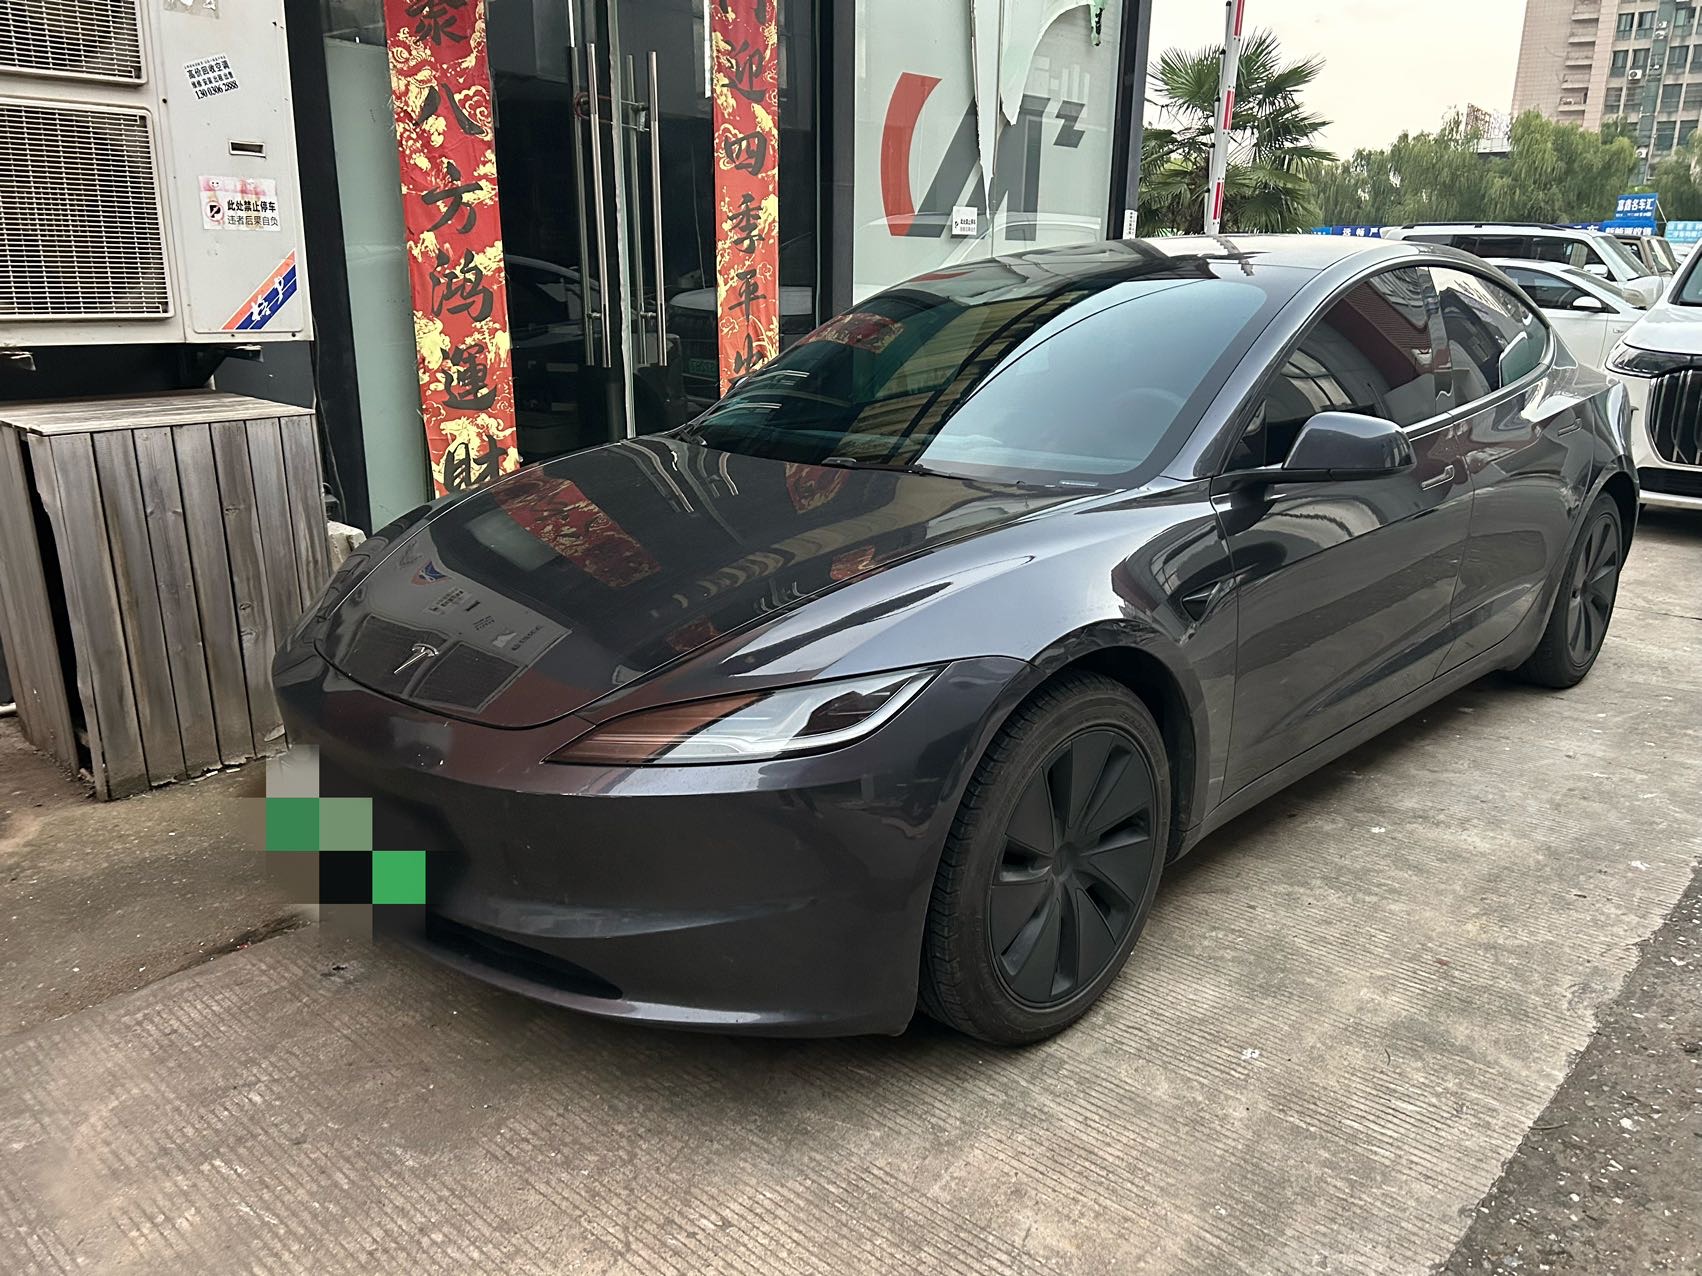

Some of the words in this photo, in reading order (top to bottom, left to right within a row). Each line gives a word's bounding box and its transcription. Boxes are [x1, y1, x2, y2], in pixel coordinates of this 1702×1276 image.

[187, 60, 230, 79] 高价回收空调
[227, 200, 276, 212] 此处禁止停车
[227, 216, 278, 227] 违者后果自负
